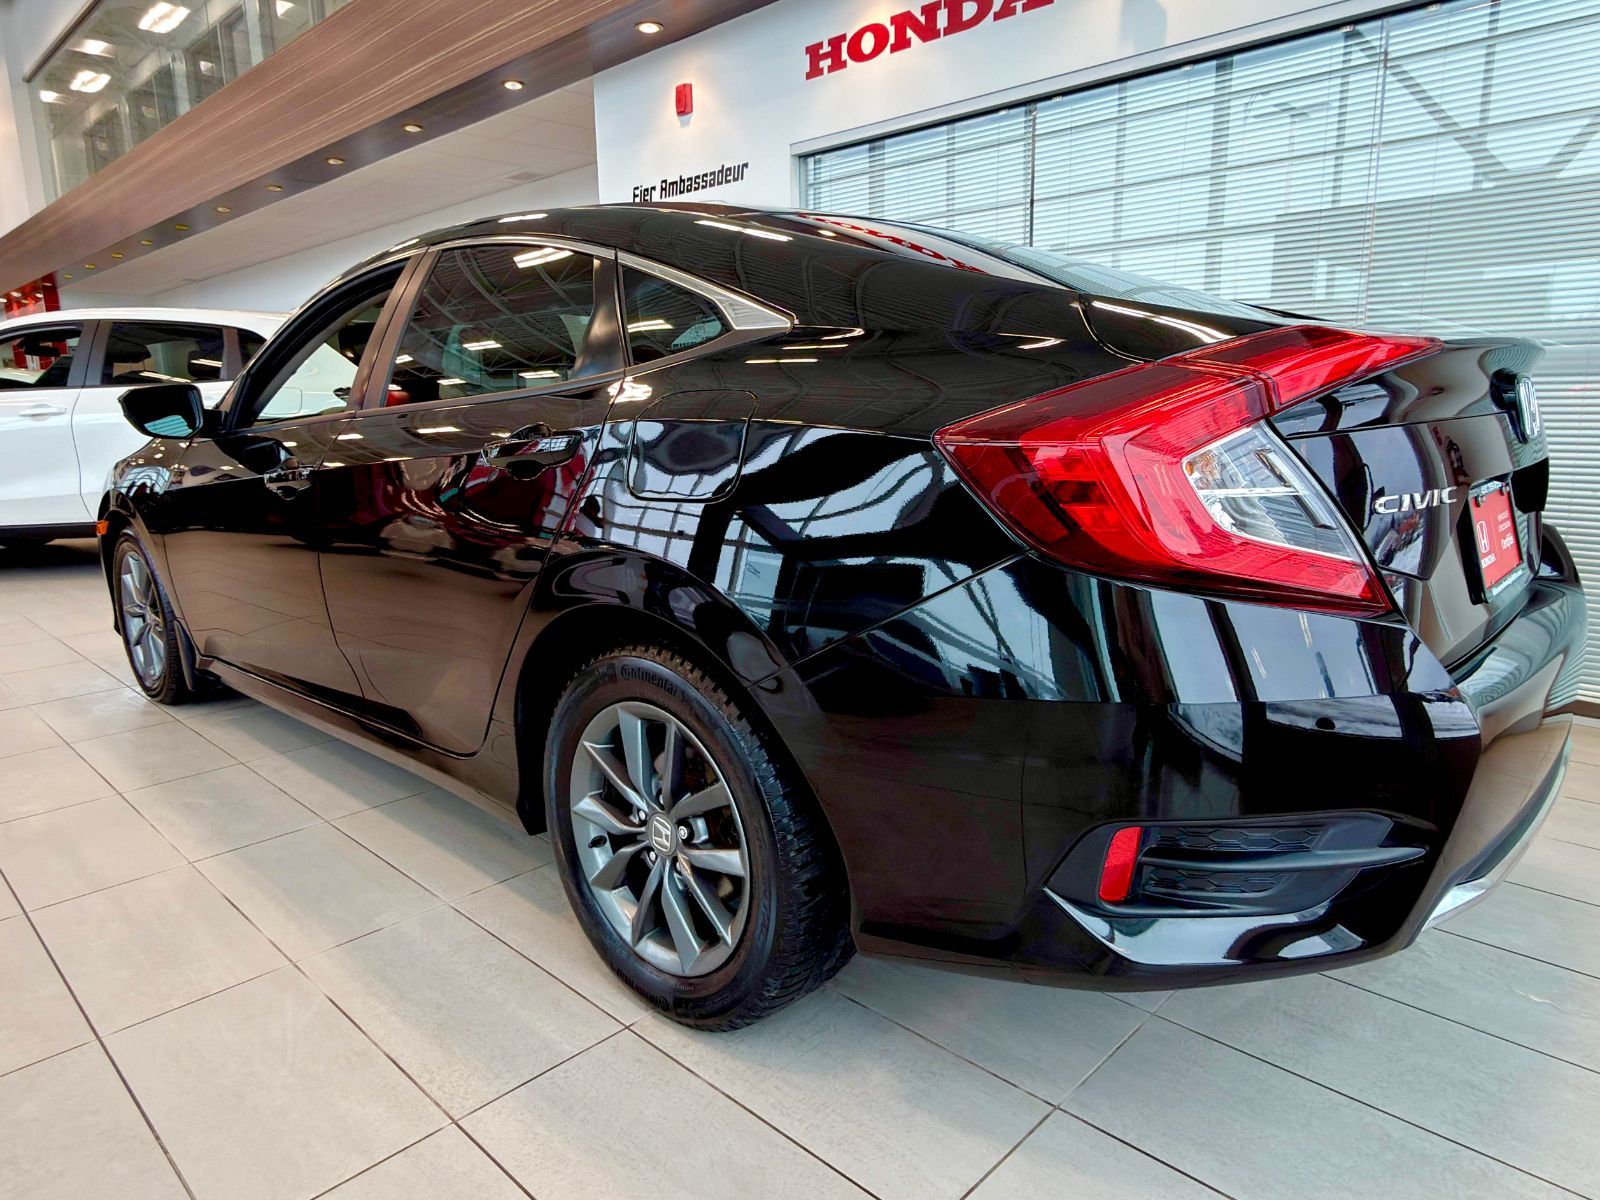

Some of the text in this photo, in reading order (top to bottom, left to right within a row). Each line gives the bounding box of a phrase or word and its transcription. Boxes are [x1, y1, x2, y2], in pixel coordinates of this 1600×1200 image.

[632, 162, 749, 202] Fier Ambassadeur
[1374, 486, 1457, 514] CIVIC
[620, 663, 677, 697] Continental
